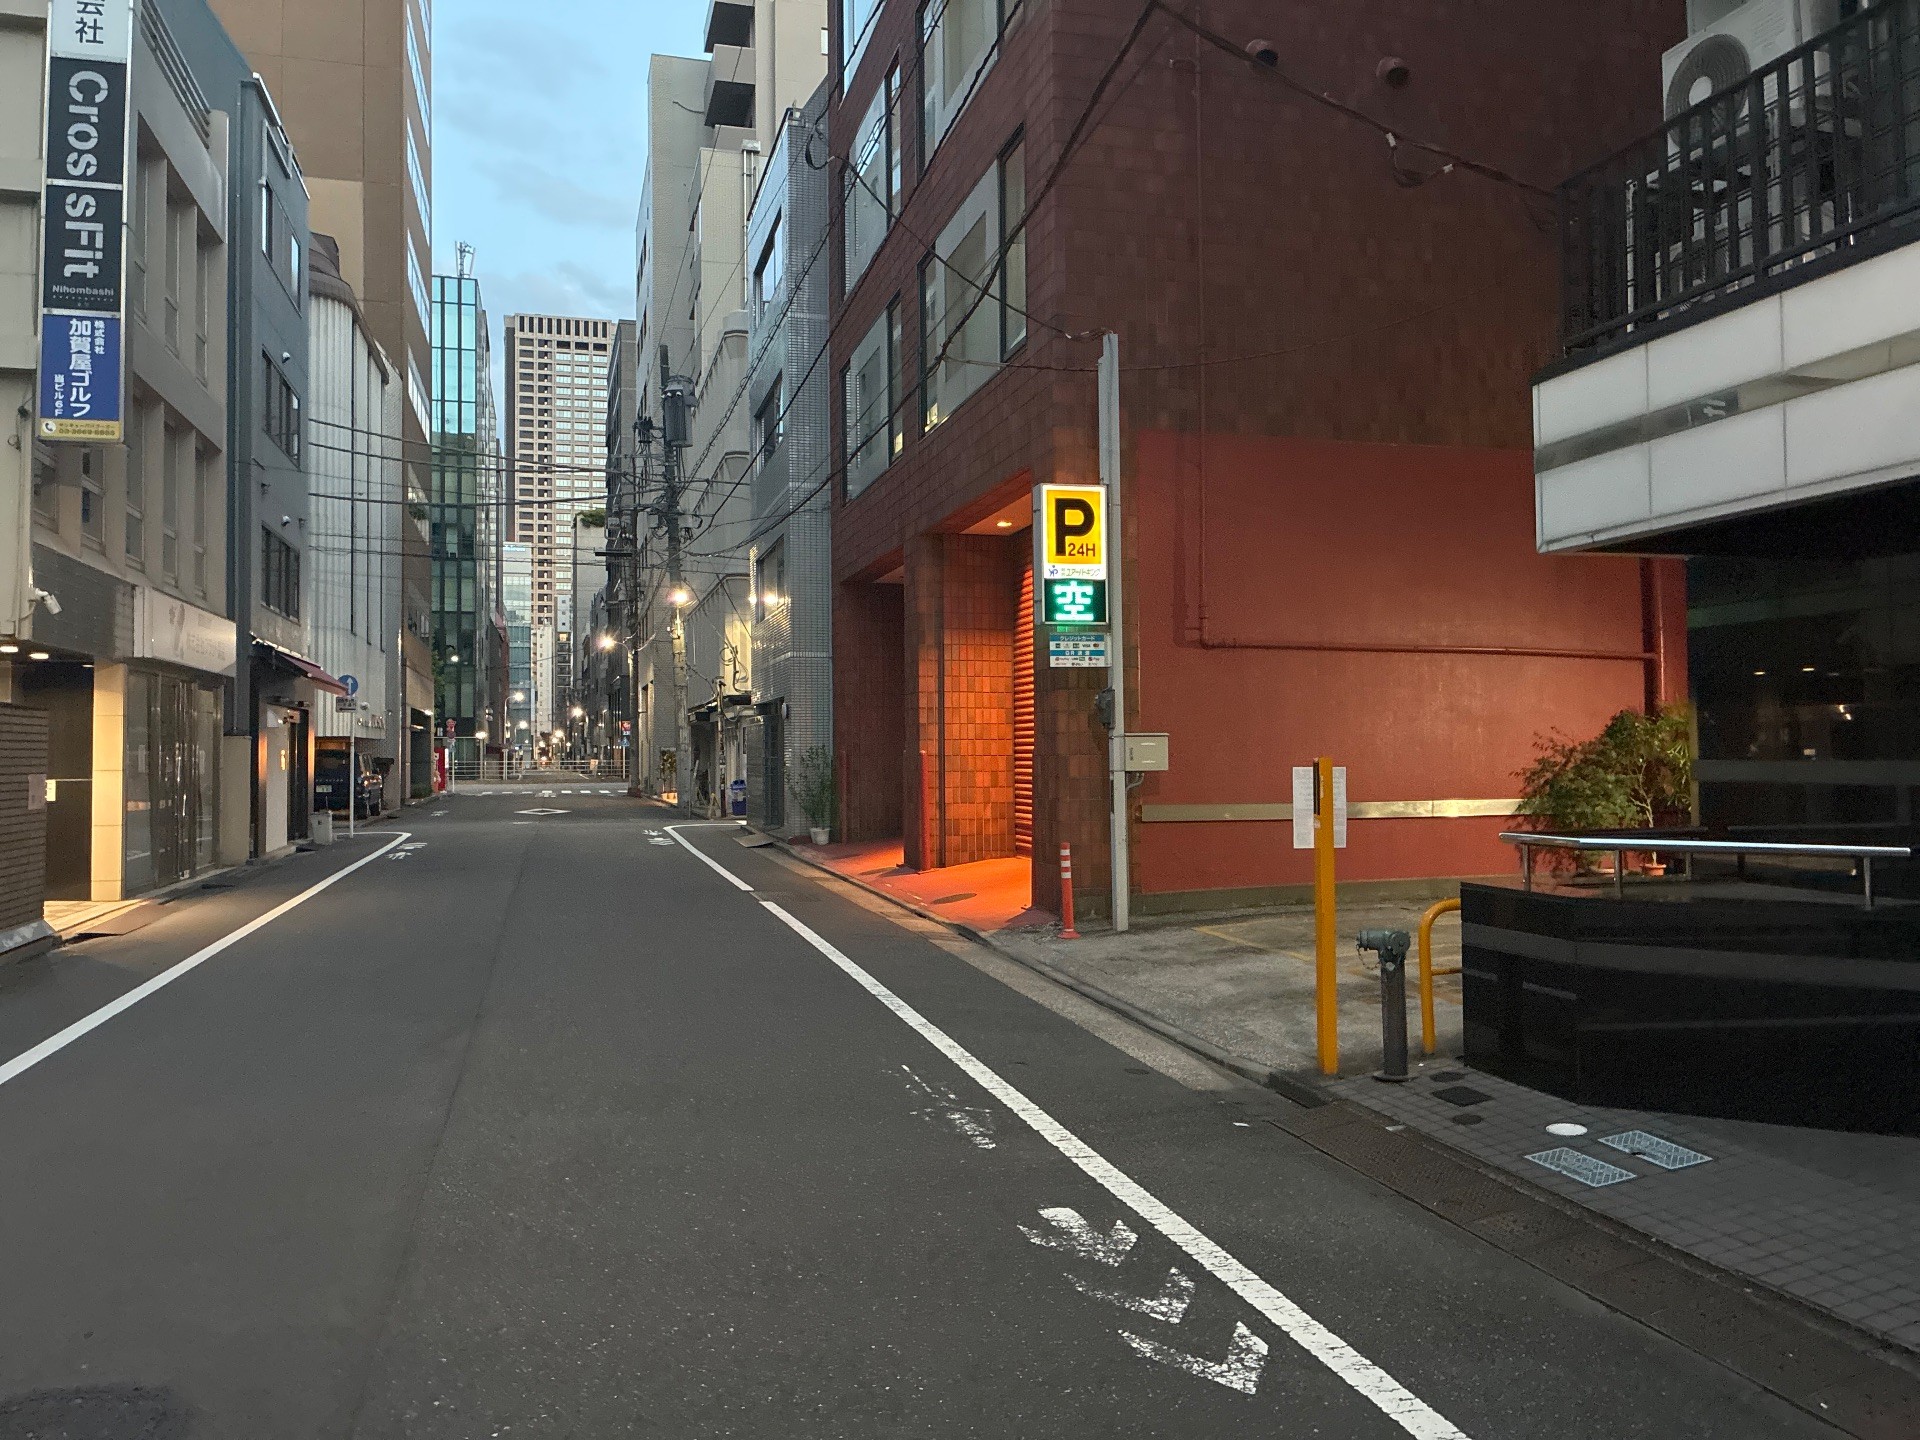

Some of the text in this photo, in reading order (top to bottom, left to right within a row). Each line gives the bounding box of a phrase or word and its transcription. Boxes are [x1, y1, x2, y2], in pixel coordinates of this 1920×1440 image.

[52, 284, 114, 296] Nihombashi
[94, 320, 105, 355] 株式会社
[69, 318, 92, 417] 加賀屋ゴルフ
[1055, 498, 1095, 556] P
[1068, 543, 1096, 557] 24H
[1053, 581, 1094, 621] 空
